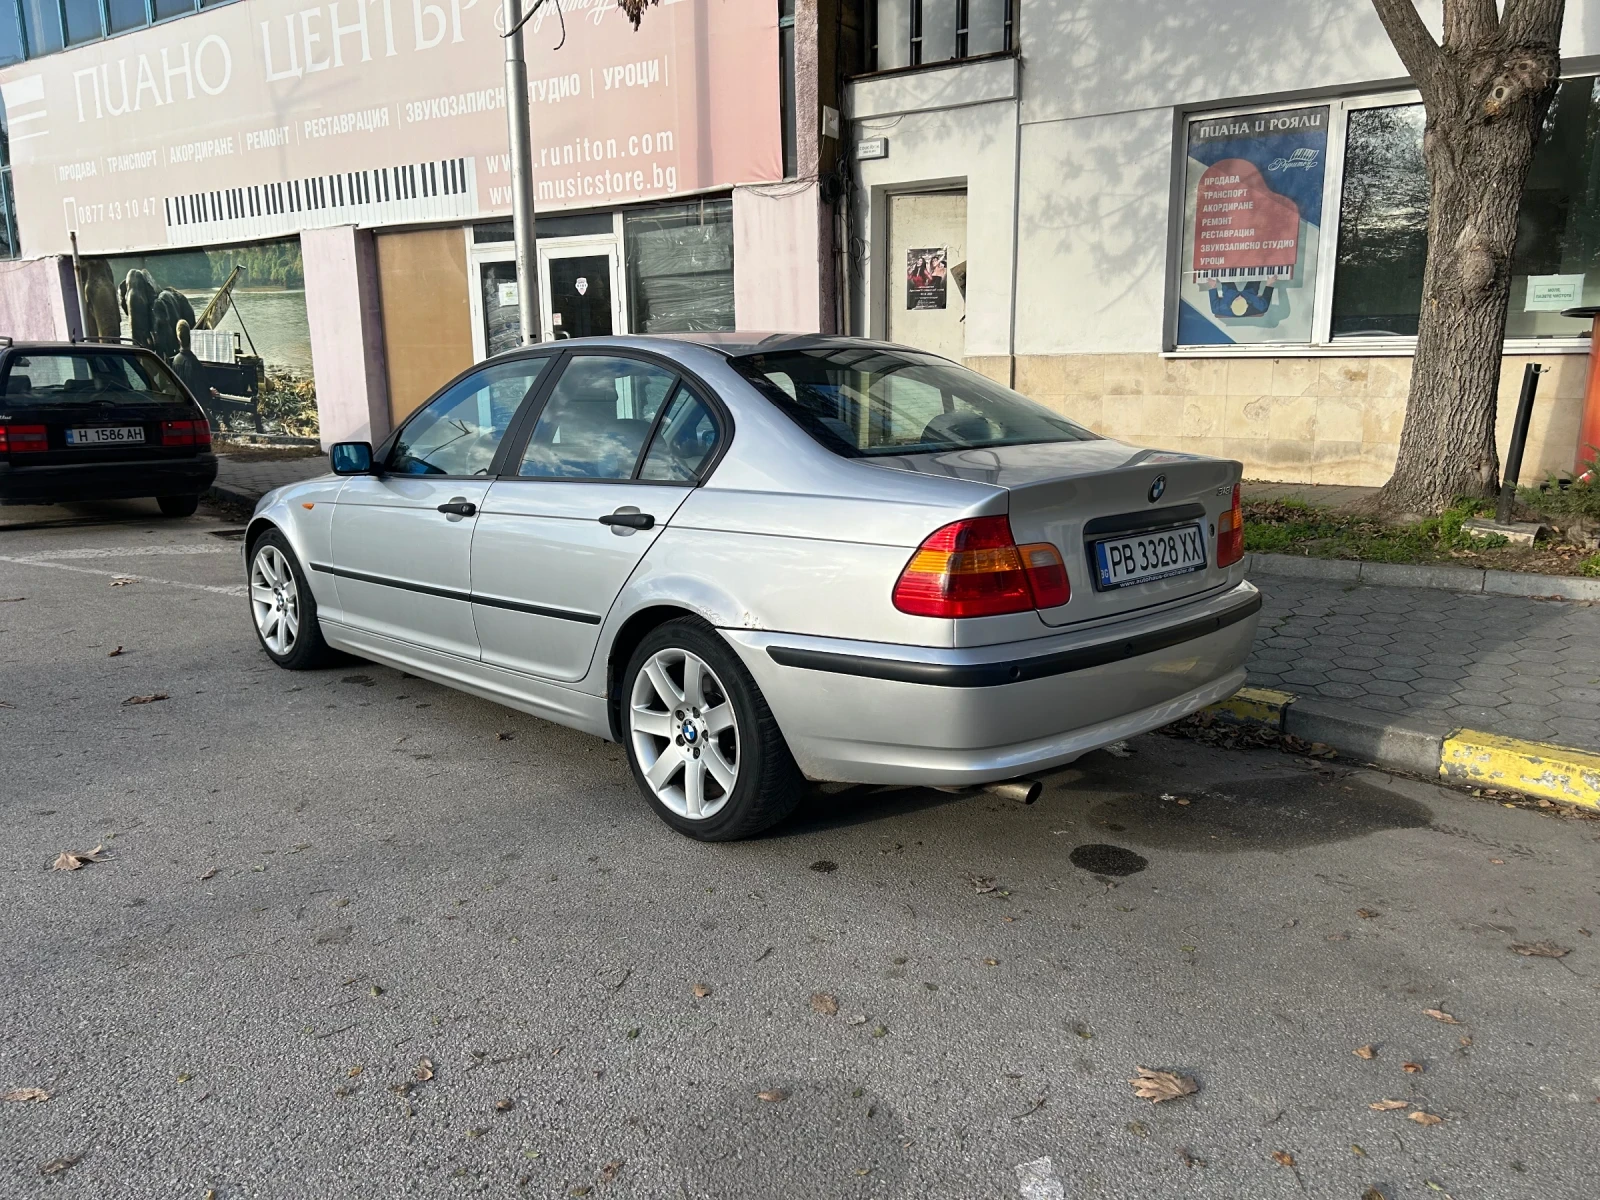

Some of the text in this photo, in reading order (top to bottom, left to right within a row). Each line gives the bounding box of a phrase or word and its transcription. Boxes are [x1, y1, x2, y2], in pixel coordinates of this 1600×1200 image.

[72, 34, 232, 123] ПИАНО
[59, 59, 660, 182] ПРОДАВА ТРАНСПОРТ АКОРДИРАНЕ РЕМОНТ РЕСТАВРАЦИЯ ЗВУКОЗАПИСН ТУДИО УРОЦИ
[1200, 114, 1321, 138] ПИАНА И РОЯЛИ
[486, 130, 674, 174] ww.runiton.com
[489, 162, 677, 205] ww.musicstore.bg
[1204, 175, 1240, 186] ПРОДАВА
[1203, 188, 1248, 199] ТРАНСПОРТ
[79, 197, 156, 224] 0877 43 10 47
[1203, 201, 1254, 212] АКОРДИРАНЕ
[1202, 217, 1232, 226] РЕМОНТ
[1201, 228, 1255, 239] РЕСТАВРАЦИЯ
[1200, 239, 1295, 252] ЗВУКОЗАПИСНО СТУДИО
[1200, 257, 1225, 265] УРОЦИ
[79, 430, 88, 442] H
[95, 429, 124, 441] 1586
[127, 428, 143, 440] AH
[1109, 532, 1200, 577] PB 3328 XX
